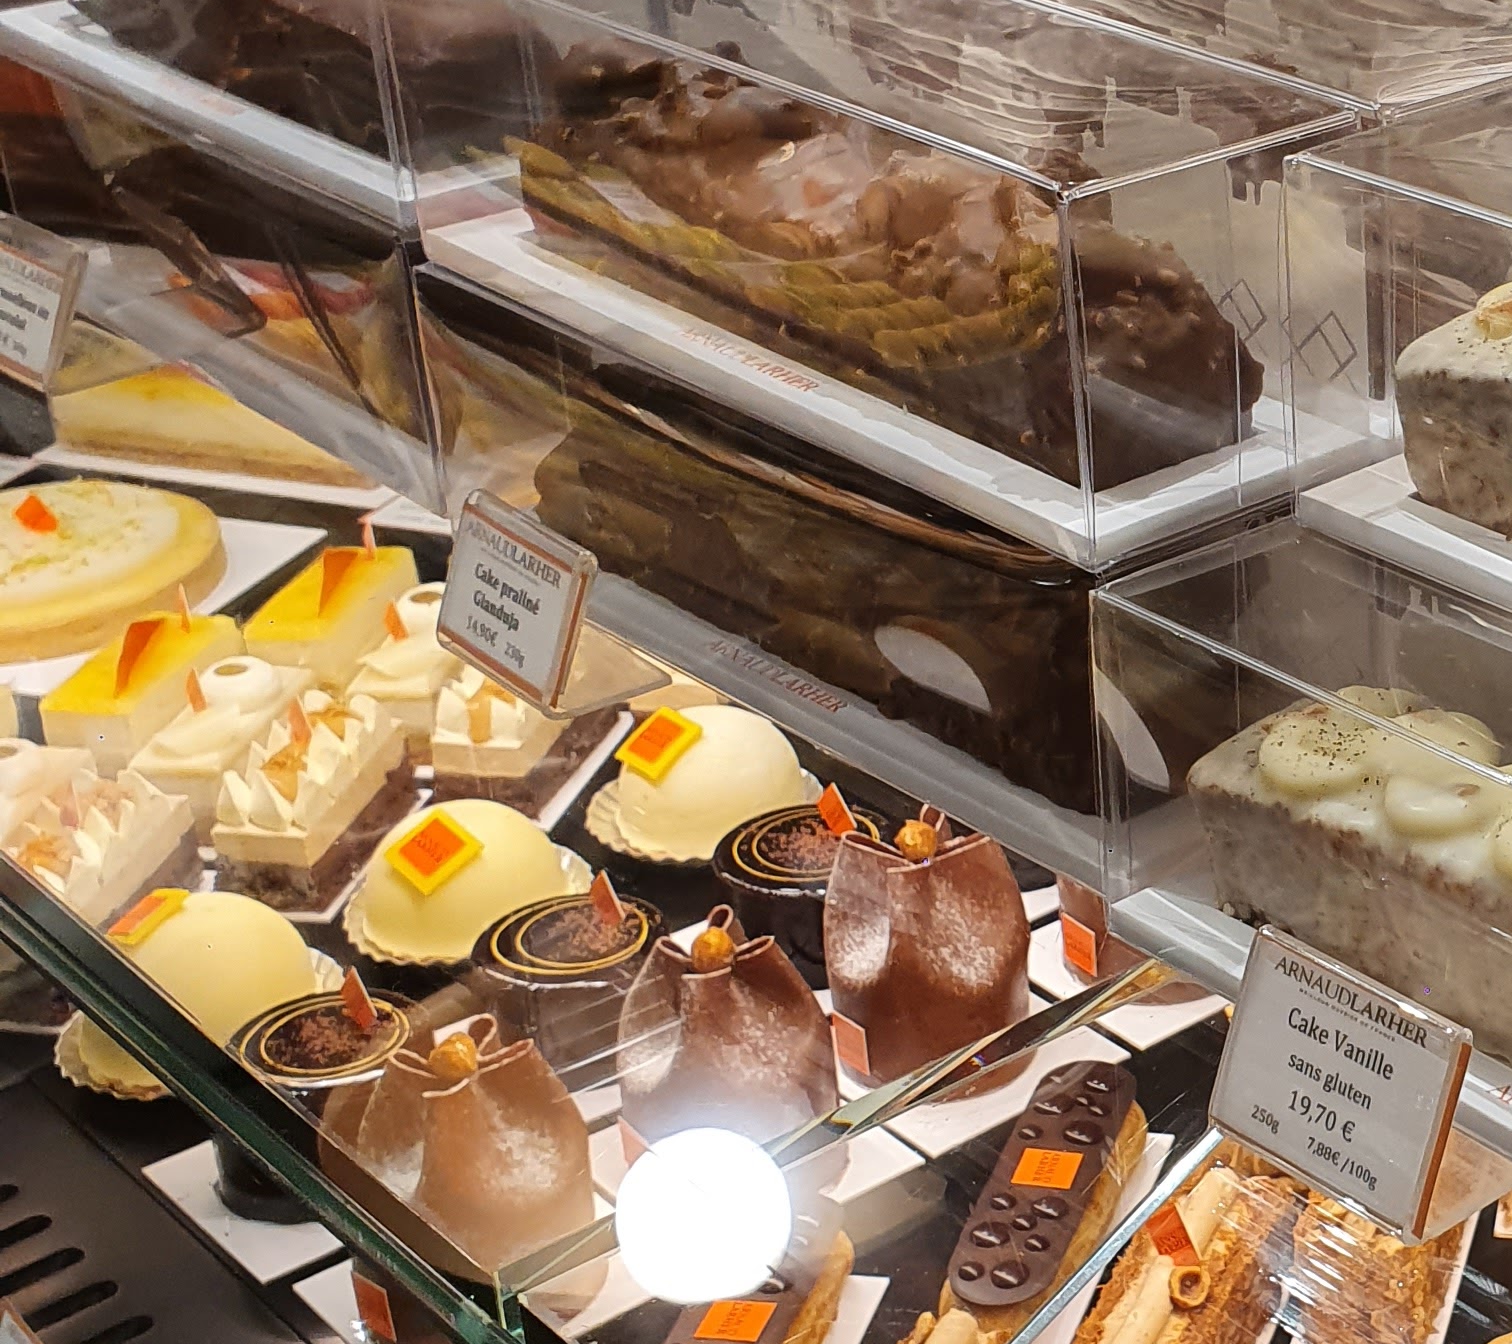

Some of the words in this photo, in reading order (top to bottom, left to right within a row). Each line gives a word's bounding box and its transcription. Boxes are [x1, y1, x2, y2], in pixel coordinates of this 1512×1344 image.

[473, 590, 520, 632] Gianduja
[474, 563, 500, 591] Cake
[499, 582, 540, 616] praliné
[1274, 956, 1429, 1049] ARNAUDLARHER
[1288, 1007, 1329, 1045] Cake
[1335, 1029, 1394, 1081] Vanille
[1288, 1053, 1322, 1083] sans
[1322, 1072, 1372, 1110] gluten
[1288, 1090, 1337, 1132] 19,70
[1340, 1120, 1356, 1143] €
[1251, 1104, 1280, 1135] 250g
[1307, 1136, 1341, 1167] 7,88€
[1340, 1157, 1378, 1192] /100g
